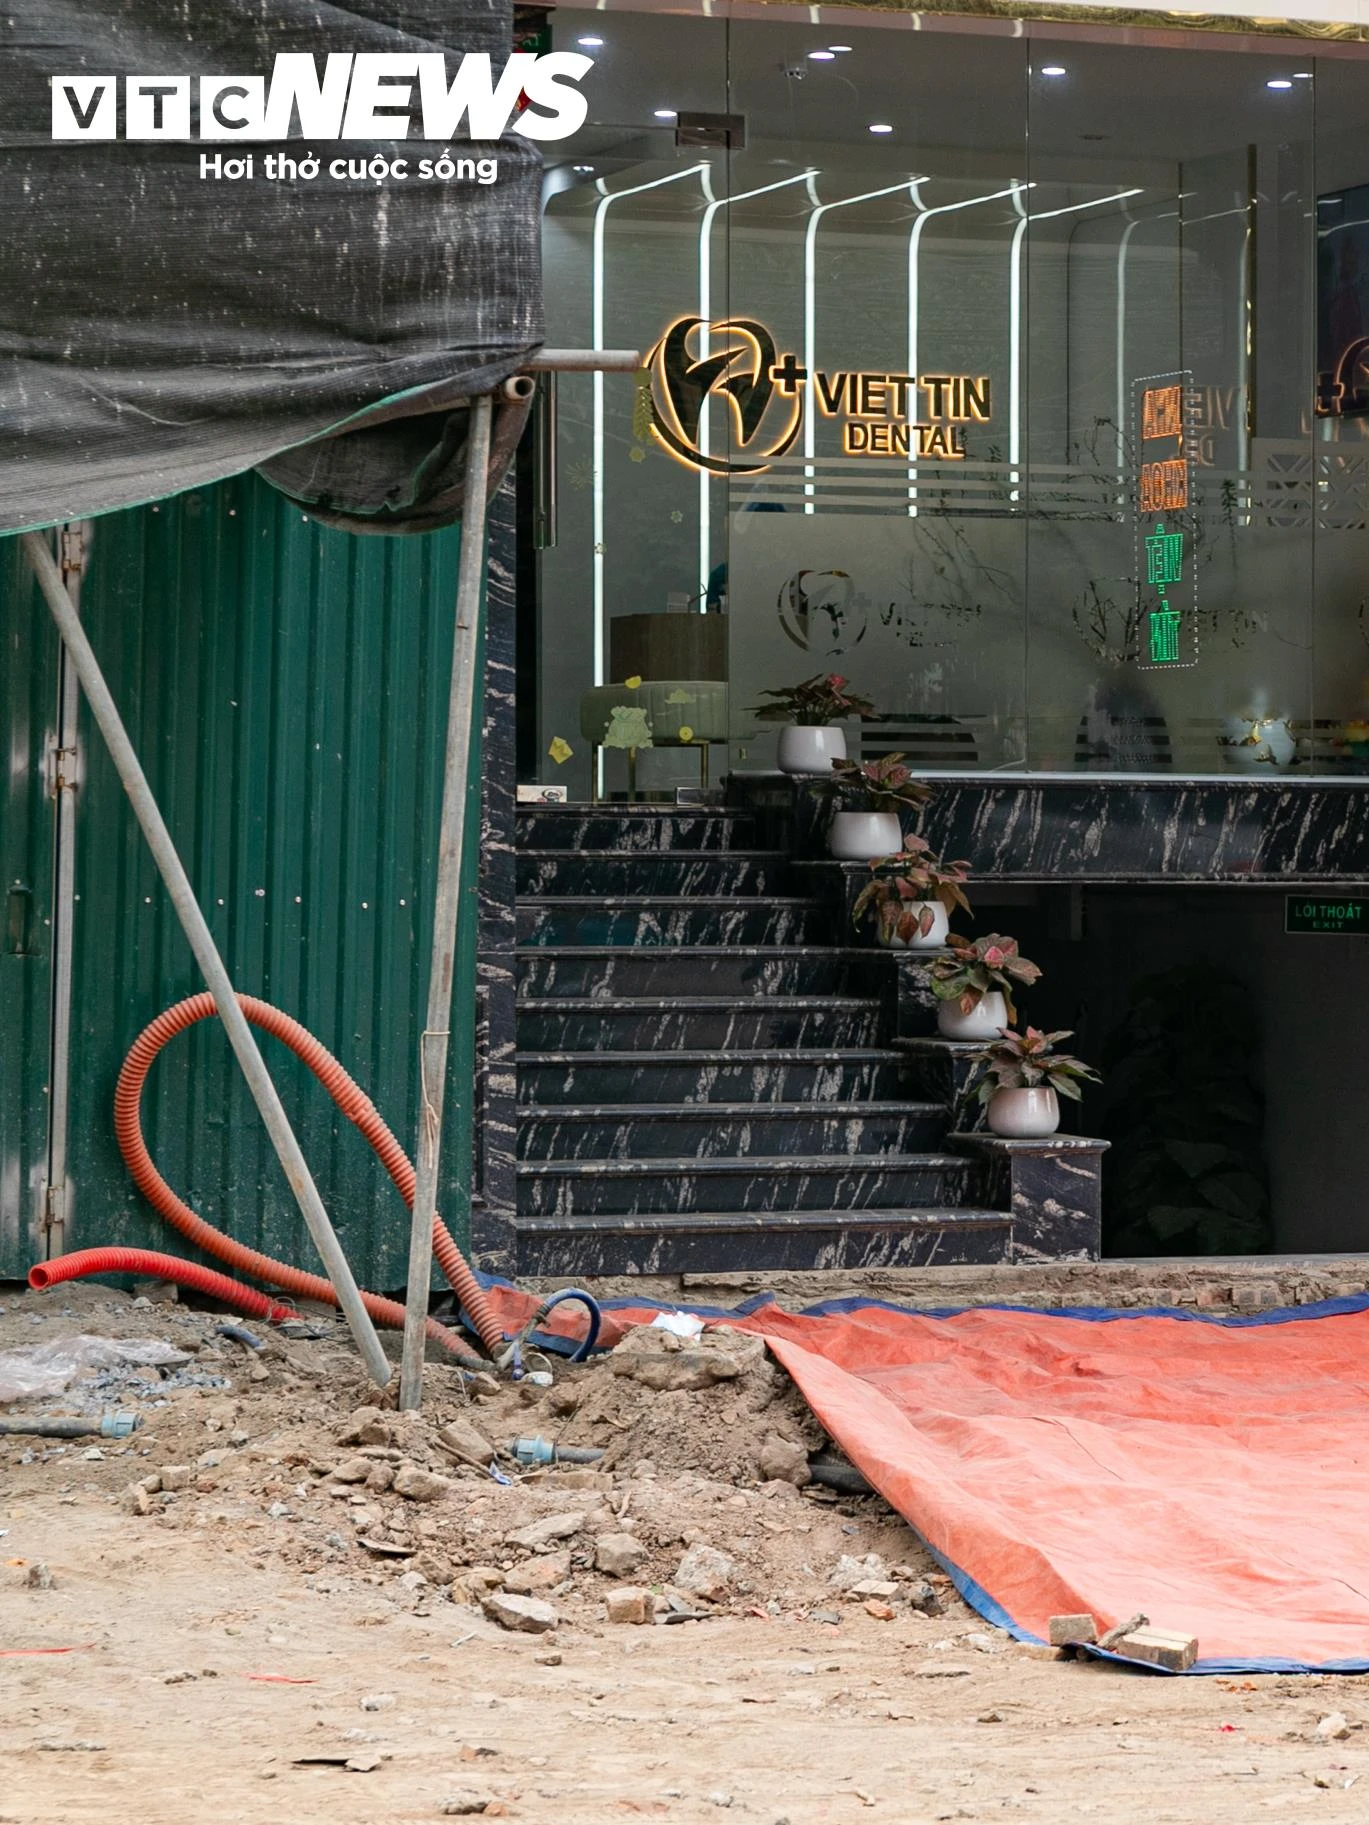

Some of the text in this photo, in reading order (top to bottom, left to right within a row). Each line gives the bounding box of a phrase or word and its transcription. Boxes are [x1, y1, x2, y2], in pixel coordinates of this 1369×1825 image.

[813, 372, 991, 421] VIET TIN
[844, 422, 966, 457] DENTAL
[1320, 903, 1362, 919] THOÁT
[1312, 921, 1344, 929] EXIT
